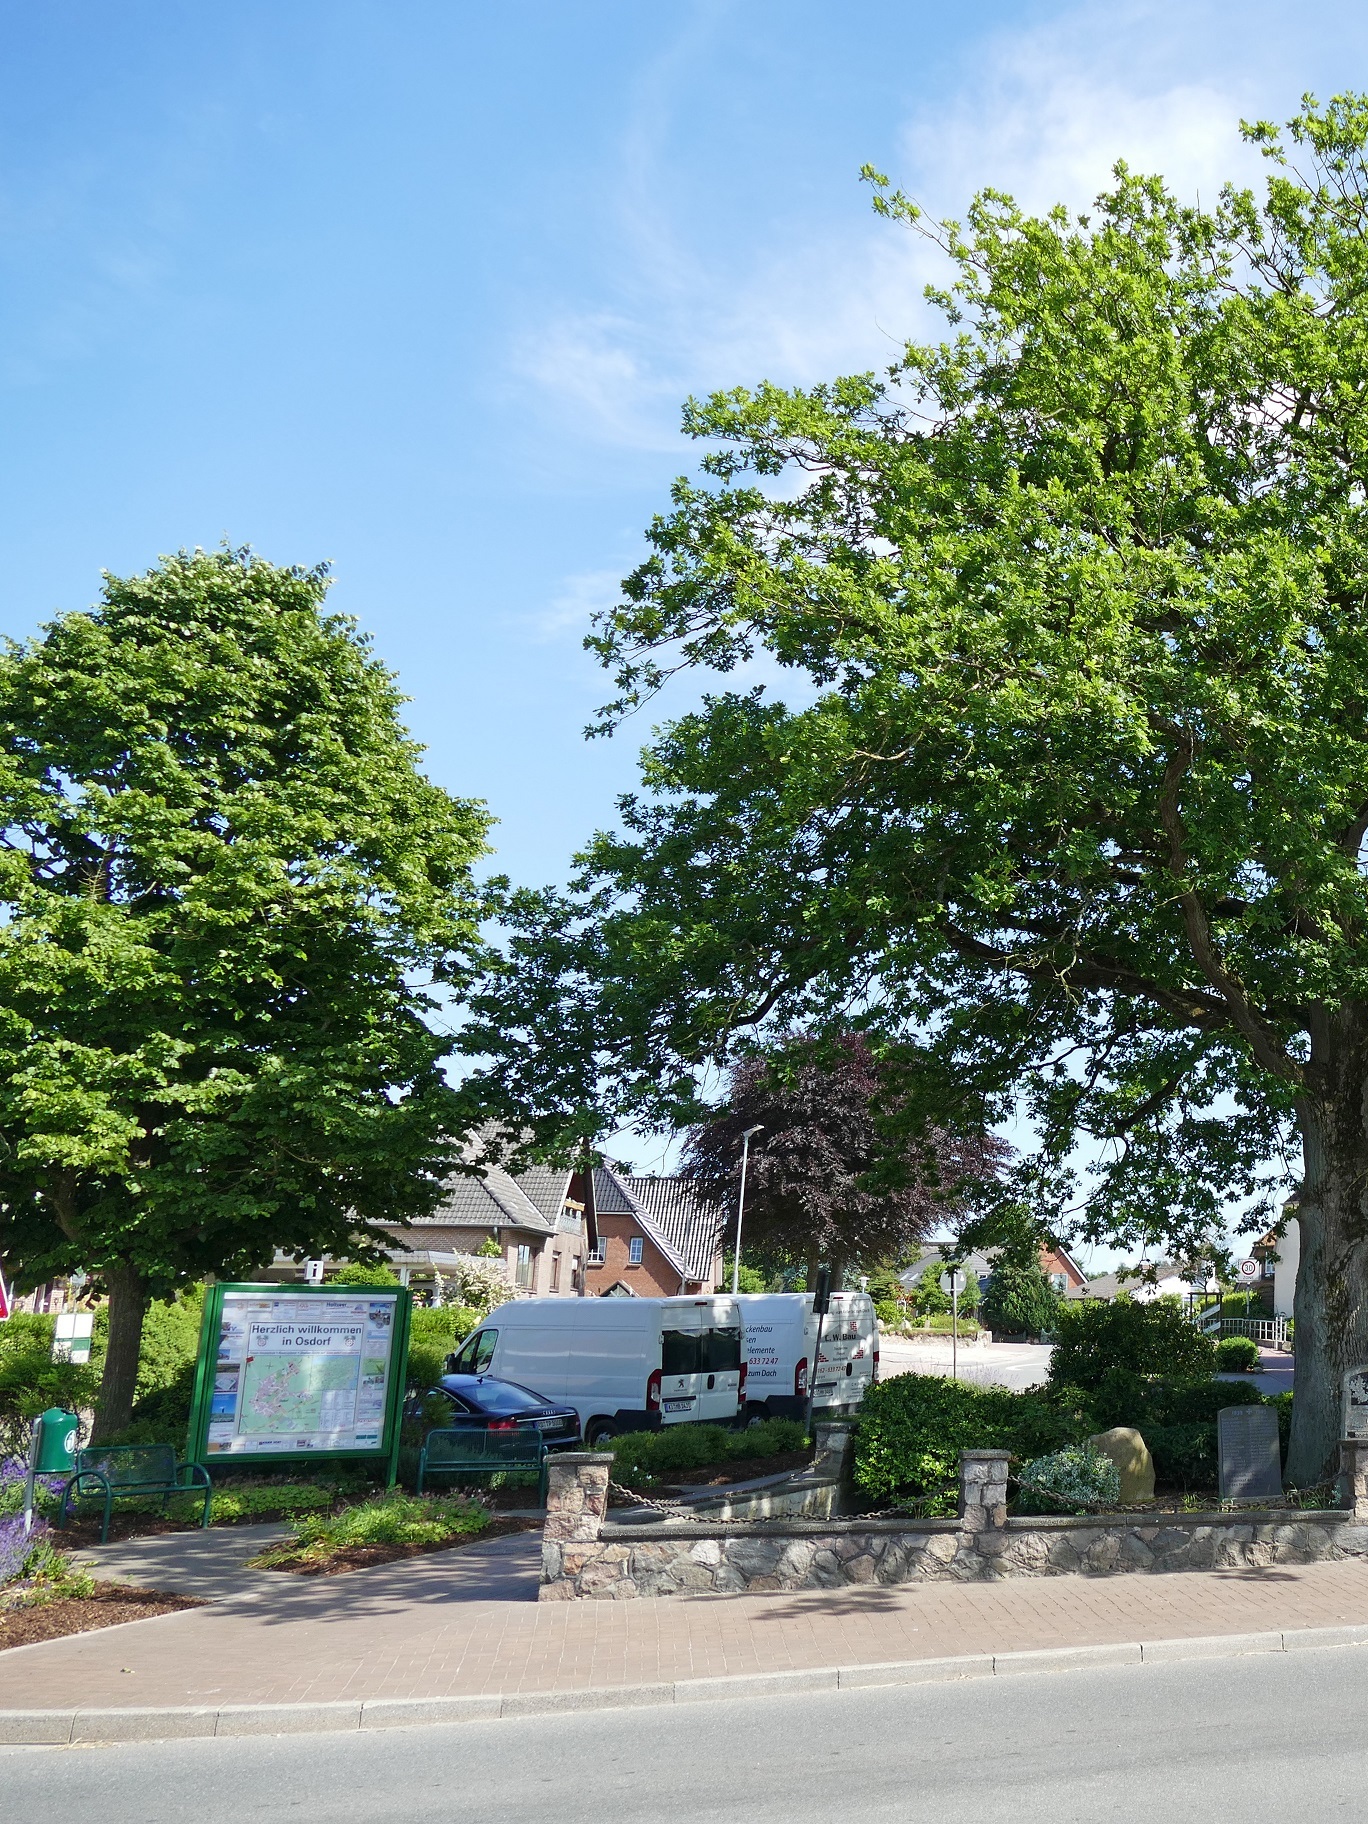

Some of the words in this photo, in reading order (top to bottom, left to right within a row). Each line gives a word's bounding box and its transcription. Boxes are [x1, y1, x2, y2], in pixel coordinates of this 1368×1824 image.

[251, 1324, 295, 1335] Herzlich
[297, 1324, 362, 1335] willkommen
[282, 1336, 292, 1346] in
[295, 1336, 332, 1346] Osdorf
[842, 1333, 856, 1341] Bau
[749, 1357, 761, 1365] 633
[761, 1357, 770, 1365] 72
[770, 1357, 779, 1365] 47
[761, 1368, 777, 1377] Dach
